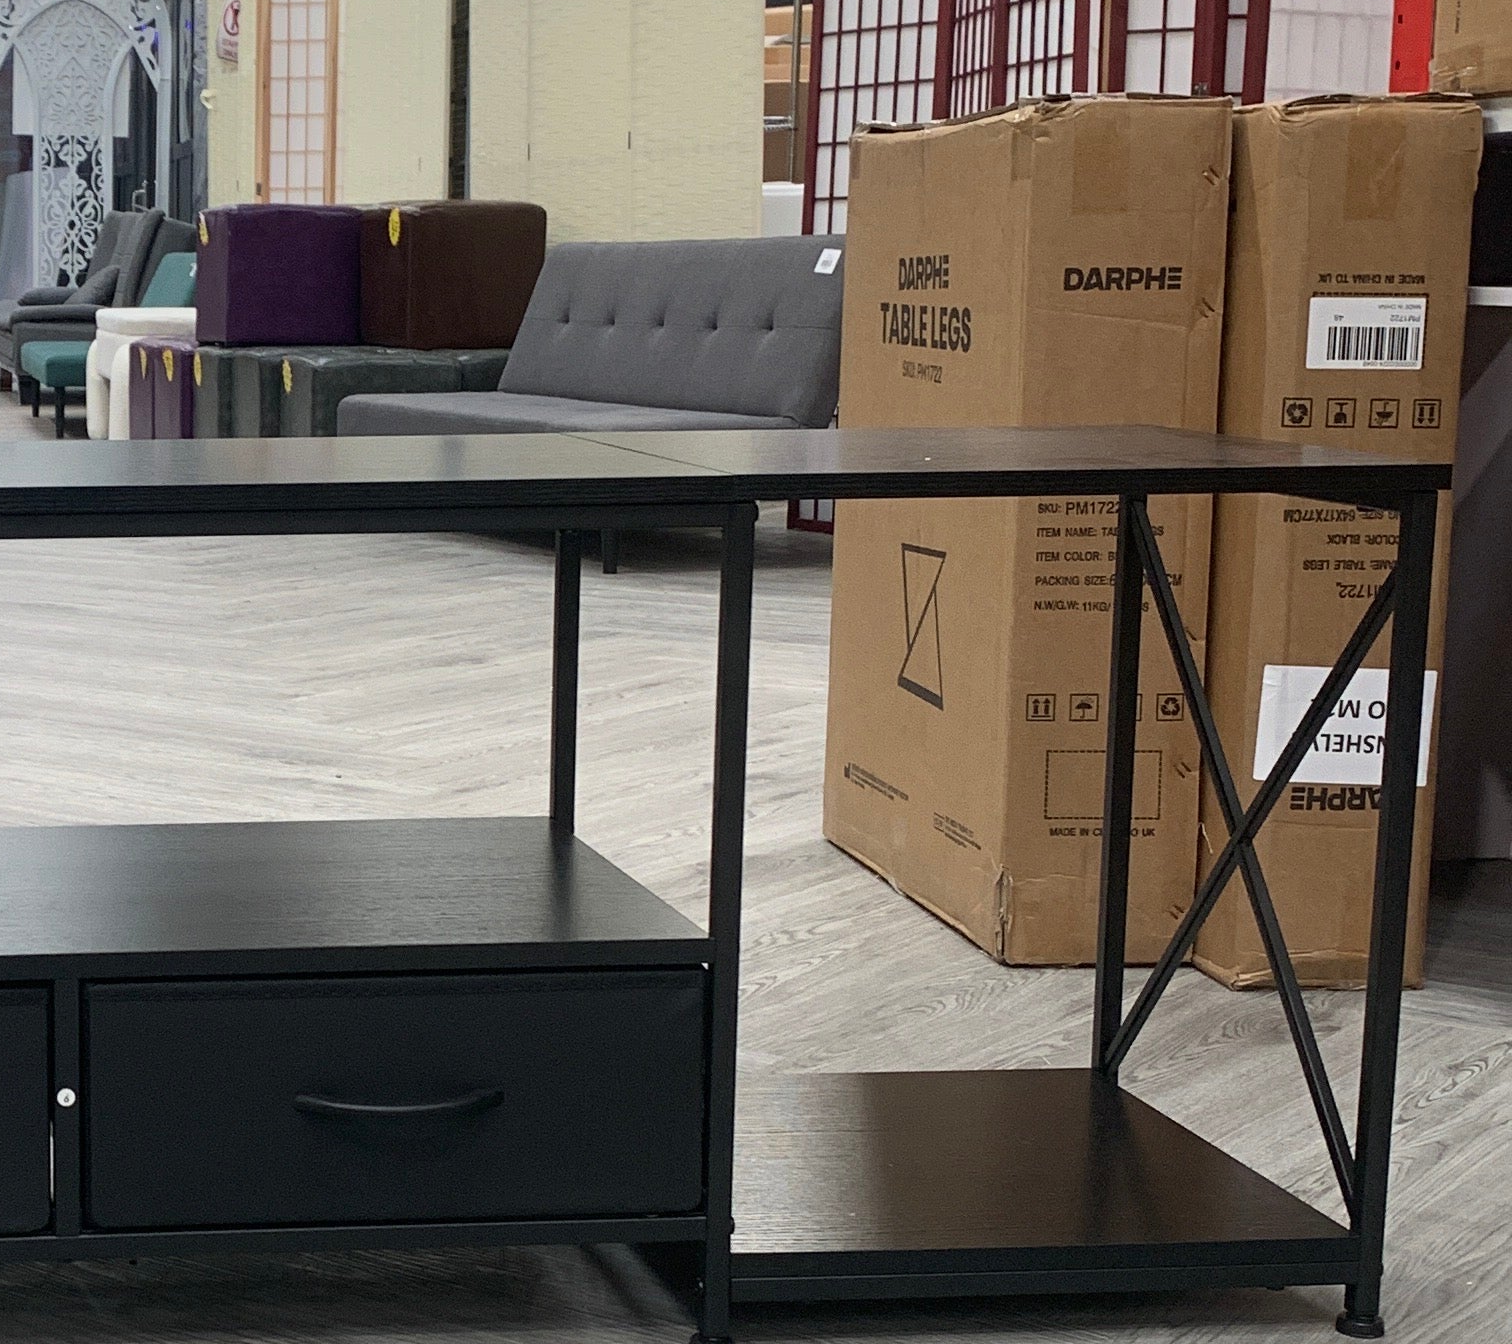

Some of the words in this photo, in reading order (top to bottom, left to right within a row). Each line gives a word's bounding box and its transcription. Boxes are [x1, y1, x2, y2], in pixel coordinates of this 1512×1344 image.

[898, 255, 949, 290] DARPHE
[1318, 273, 1332, 283] UK
[1336, 273, 1349, 283] TO
[1063, 267, 1183, 291] DARPHE
[1352, 274, 1381, 284] CHINA
[1384, 275, 1395, 284] IN
[1398, 274, 1425, 284] MADE
[880, 302, 927, 347] TABLE
[930, 306, 971, 353] LEGS
[1038, 503, 1061, 514] SKU:
[1036, 527, 1061, 537] ITEM
[1065, 527, 1097, 537] NAME:
[1326, 534, 1361, 545] BLACK
[1035, 552, 1060, 562] ITEM
[1064, 552, 1103, 562] COLOR:
[1303, 560, 1329, 571] LEGS
[1334, 560, 1366, 571] TABLE
[1035, 575, 1080, 586] PACKING
[1290, 787, 1381, 811] ARPHE
[1049, 827, 1076, 836] MADE
[1080, 827, 1089, 836] IN
[1142, 828, 1156, 836] UK
